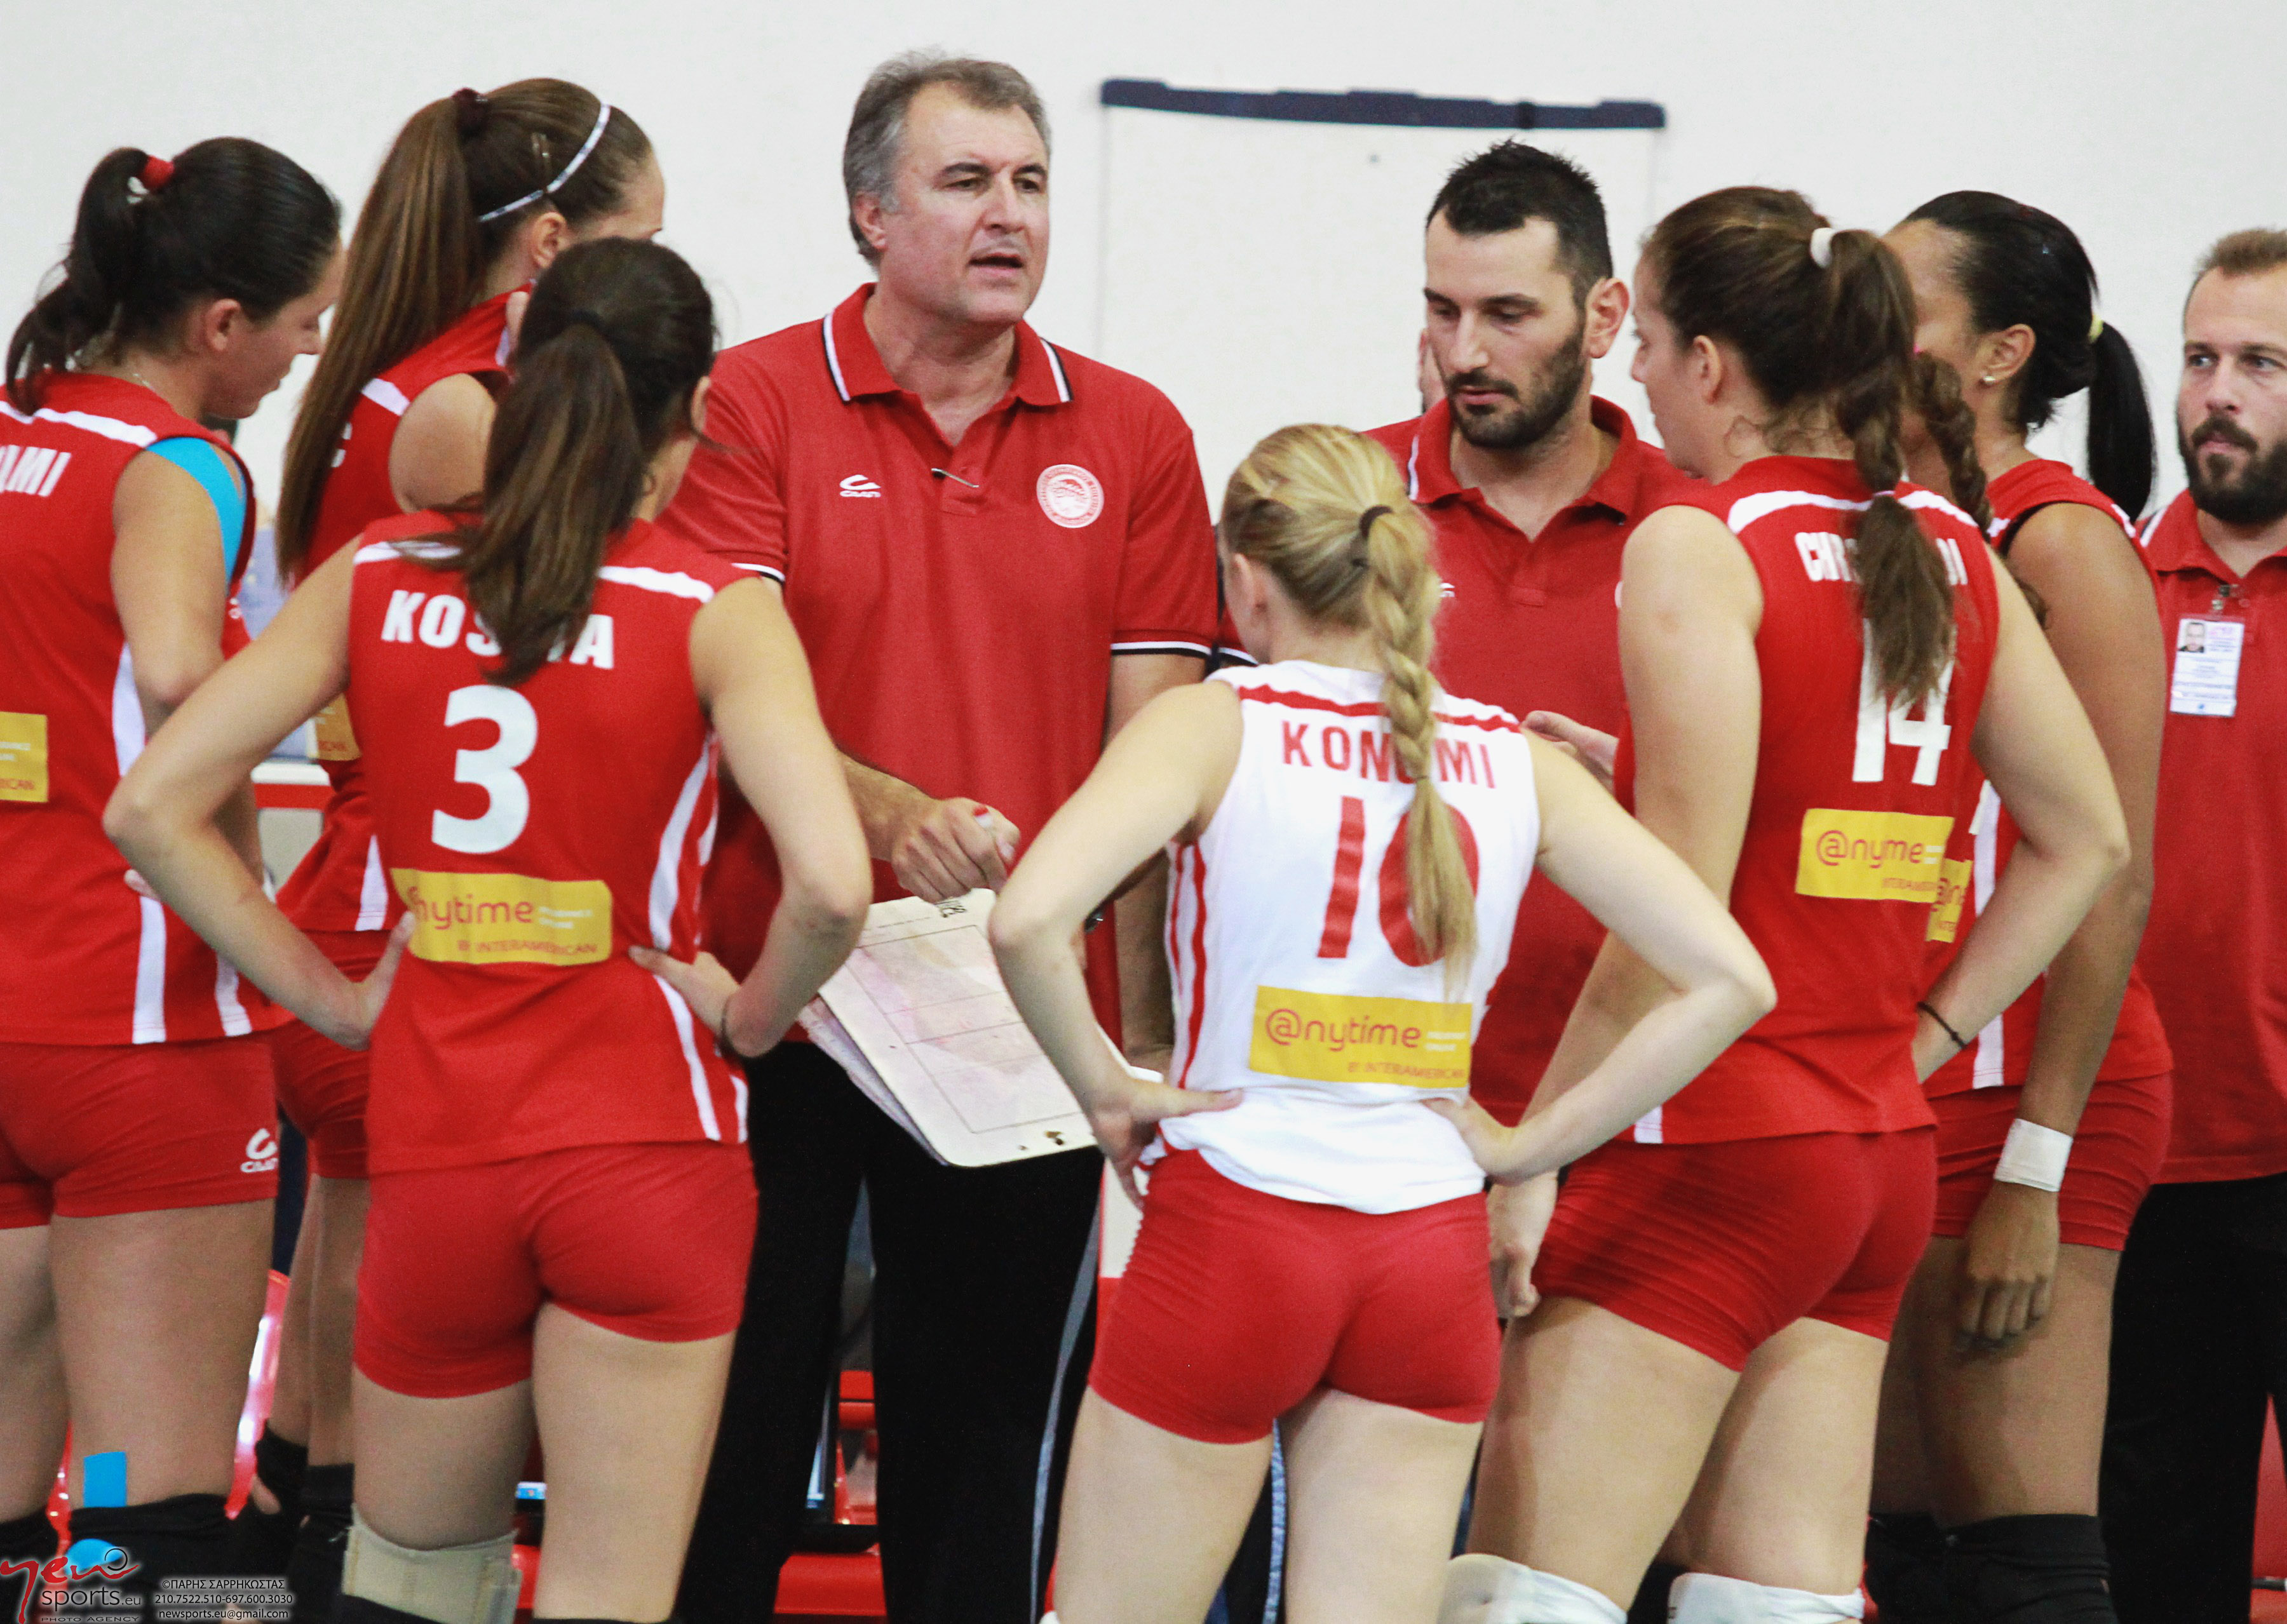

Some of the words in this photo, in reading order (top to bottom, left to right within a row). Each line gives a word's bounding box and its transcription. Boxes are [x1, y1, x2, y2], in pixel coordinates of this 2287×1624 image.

[381, 589, 614, 669] KOSA
[1852, 618, 1958, 786] 14
[431, 684, 538, 854] 3
[1316, 795, 1480, 967] 10
[1265, 1007, 1422, 1052] @nytime
